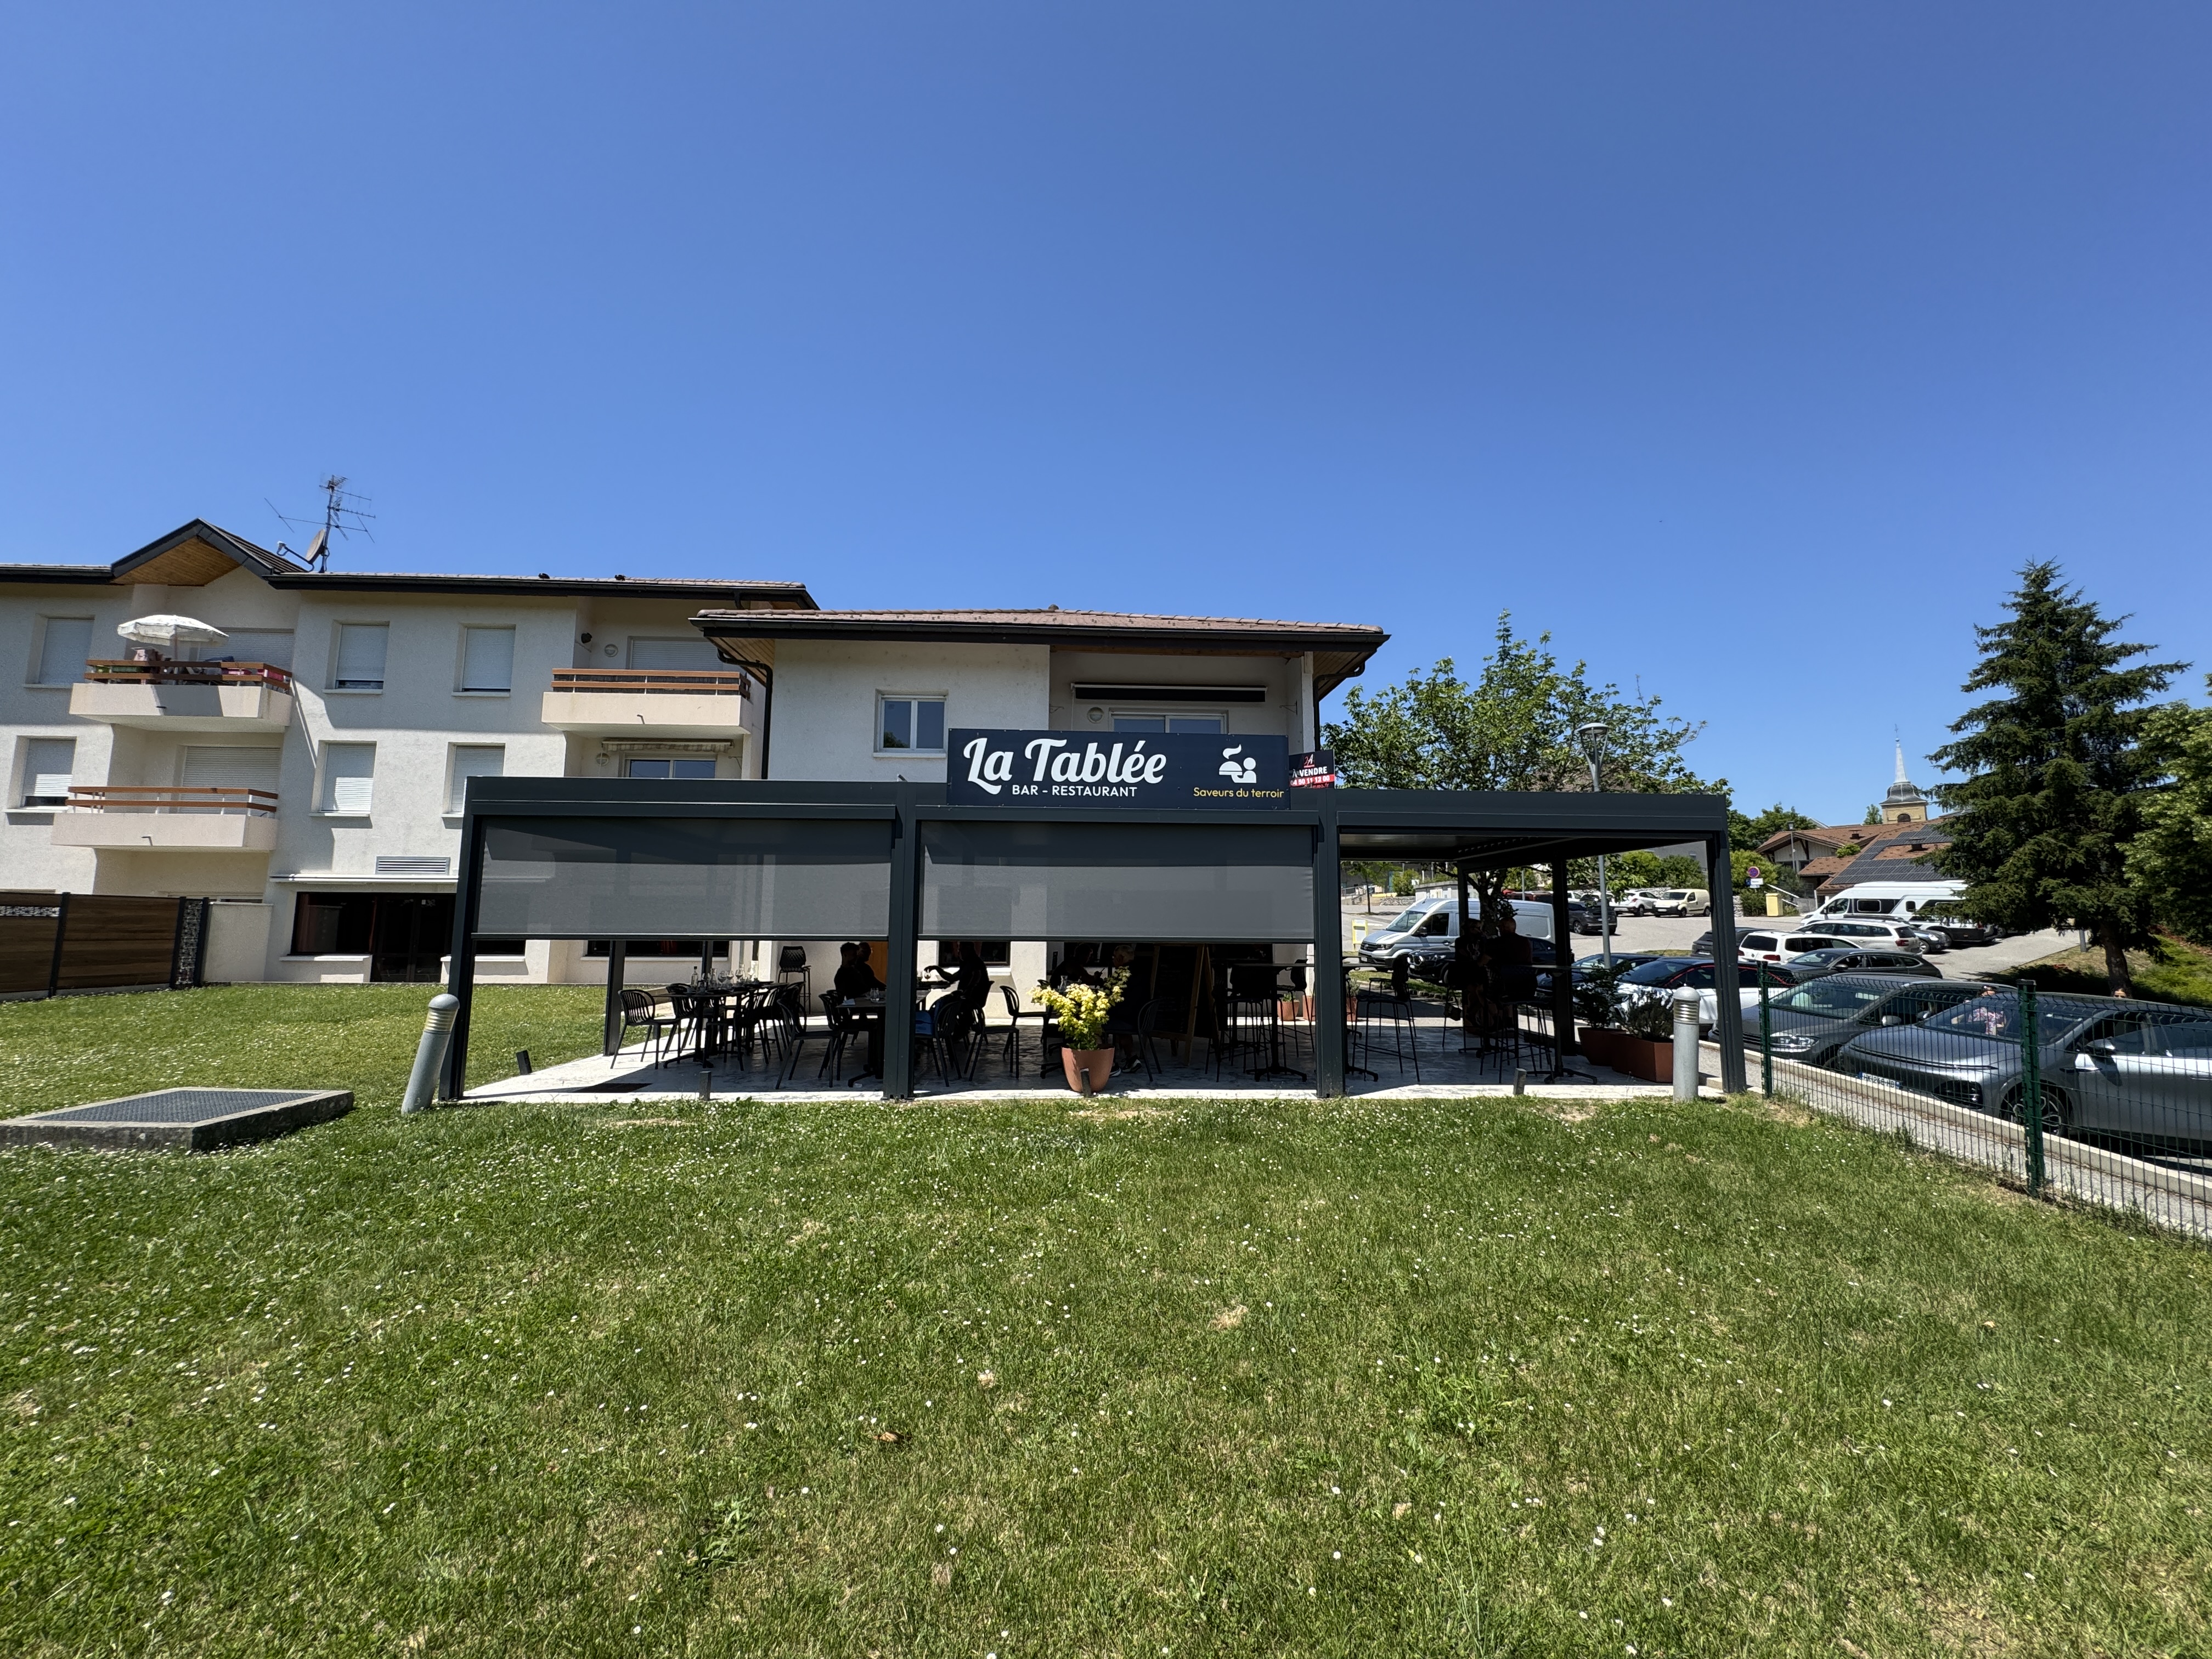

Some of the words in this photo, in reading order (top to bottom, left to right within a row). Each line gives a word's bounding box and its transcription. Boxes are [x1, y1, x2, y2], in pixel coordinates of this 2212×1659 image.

[963, 738, 1014, 795] La
[1025, 738, 1166, 784] Tablée
[1299, 766, 1328, 777] VENDRE
[1012, 785, 1039, 795] BAR
[1052, 785, 1138, 797] RESTAURANT
[1193, 787, 1234, 798] Saveurs
[1235, 787, 1249, 798] du
[1251, 788, 1285, 798] terroir
